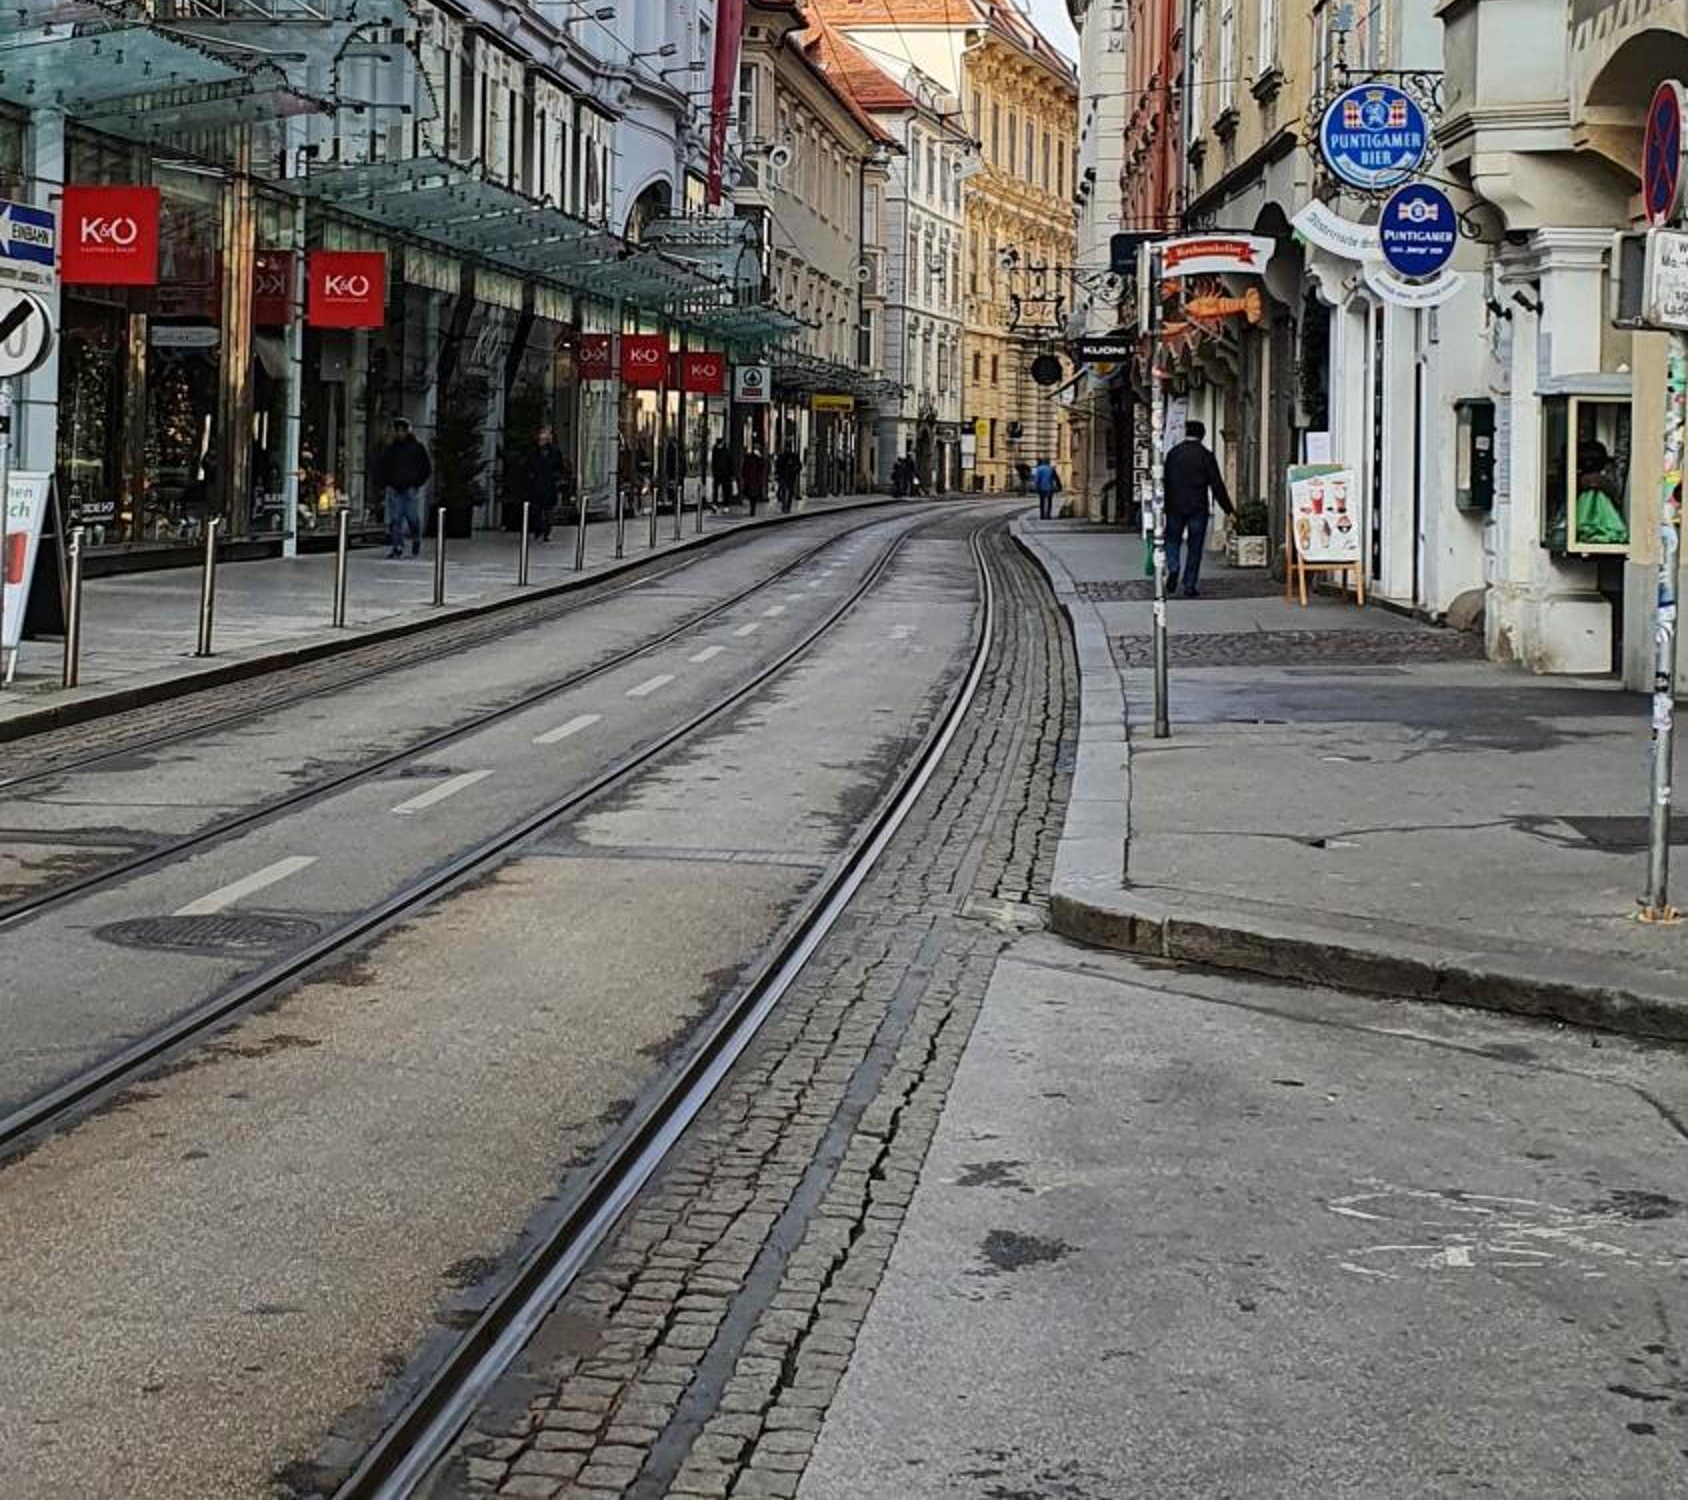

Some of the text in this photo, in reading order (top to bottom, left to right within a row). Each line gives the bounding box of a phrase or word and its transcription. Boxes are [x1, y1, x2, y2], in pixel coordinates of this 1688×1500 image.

[1330, 132, 1421, 149] PUNTIGAMER
[1361, 150, 1391, 165] BIER
[81, 217, 137, 245] K&O
[1384, 229, 1453, 243] PUNTIGAMER
[325, 275, 369, 297] K&O
